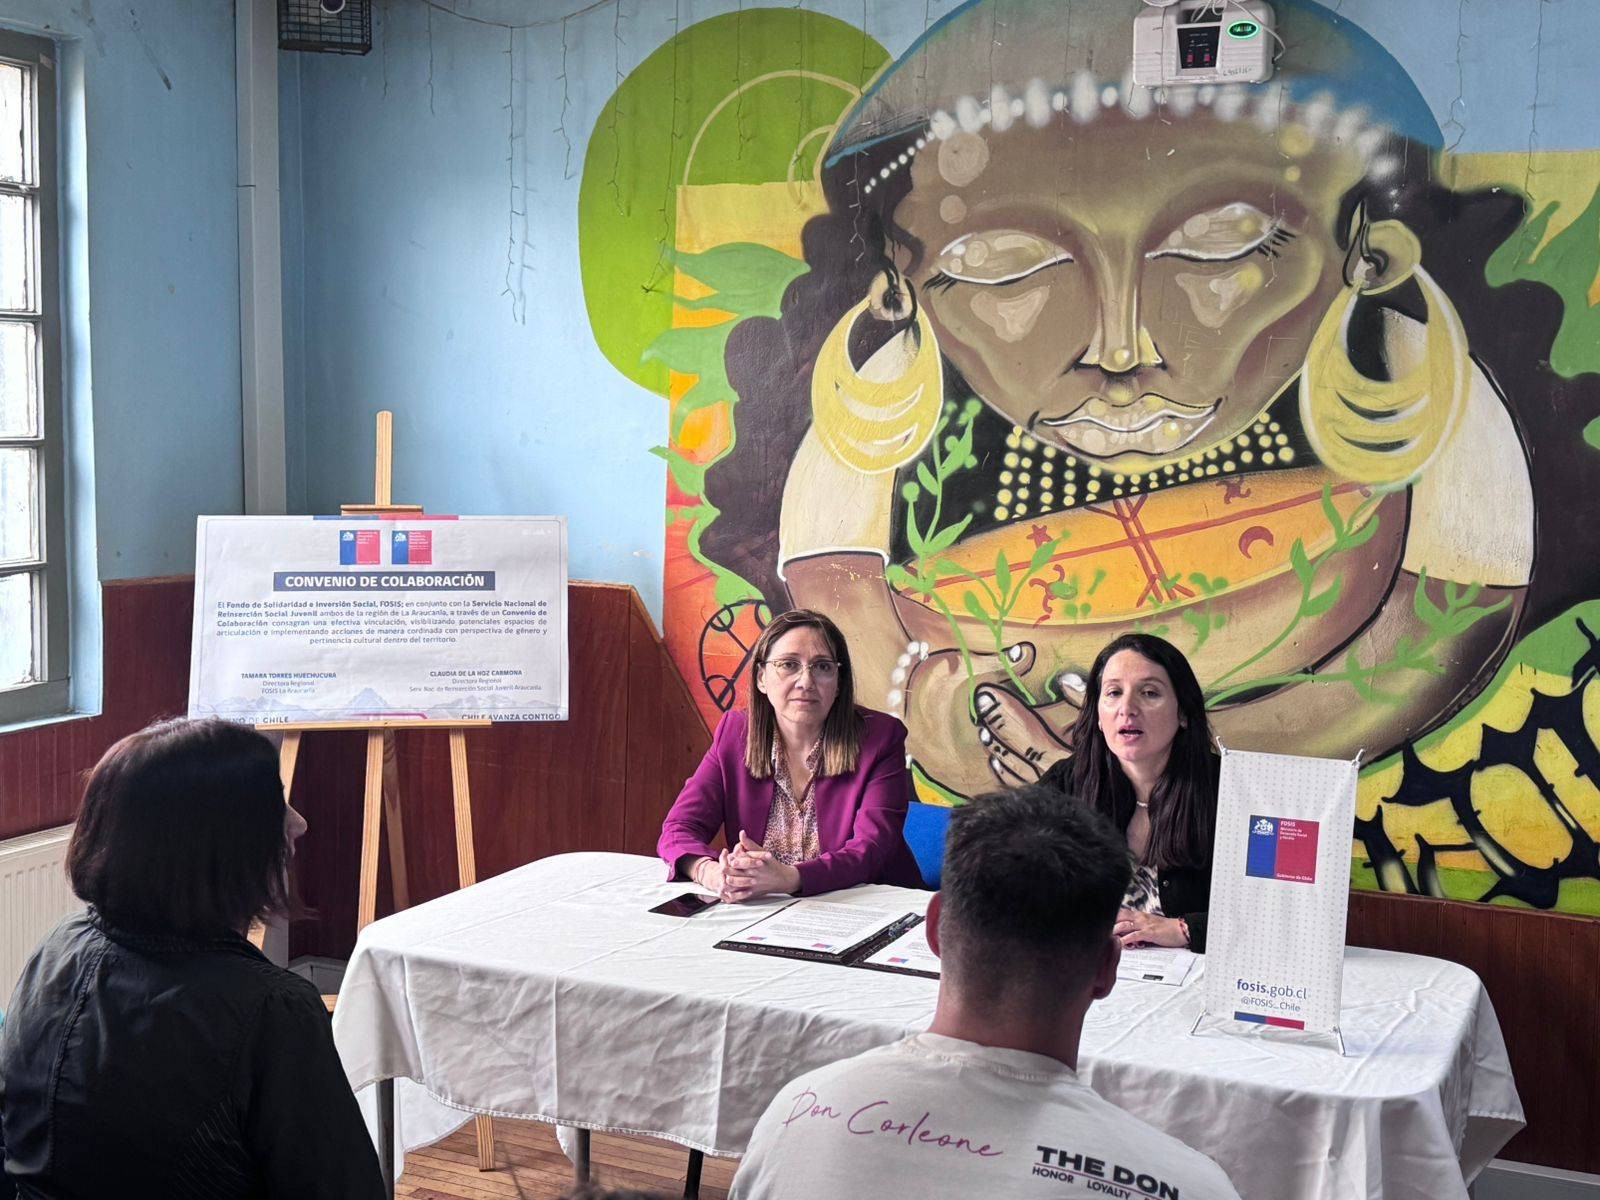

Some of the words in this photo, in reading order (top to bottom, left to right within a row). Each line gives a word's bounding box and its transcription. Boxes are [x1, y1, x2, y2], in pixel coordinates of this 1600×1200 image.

[285, 576, 356, 588] CONVENIO
[360, 576, 378, 587] DE
[381, 574, 485, 587] COLABORACIÓN
[416, 601, 448, 609] conjunto
[217, 610, 263, 618] Reinserción
[366, 610, 388, 618] región
[271, 628, 329, 636] implementando
[460, 627, 502, 635] perspectiva
[309, 637, 352, 645] pertinencia
[353, 636, 381, 644] cultural
[384, 636, 408, 644] dentro
[1236, 978, 1307, 1000] fosis.gob.cl
[1240, 995, 1301, 1012] @FOSIS_Chile
[782, 1087, 841, 1128] Don
[847, 1101, 1003, 1157] Corleone
[1036, 1145, 1105, 1178] THE
[1112, 1165, 1180, 1200] DON
[1032, 1166, 1075, 1184] HONOR
[1086, 1179, 1132, 1200] LOYALTY
